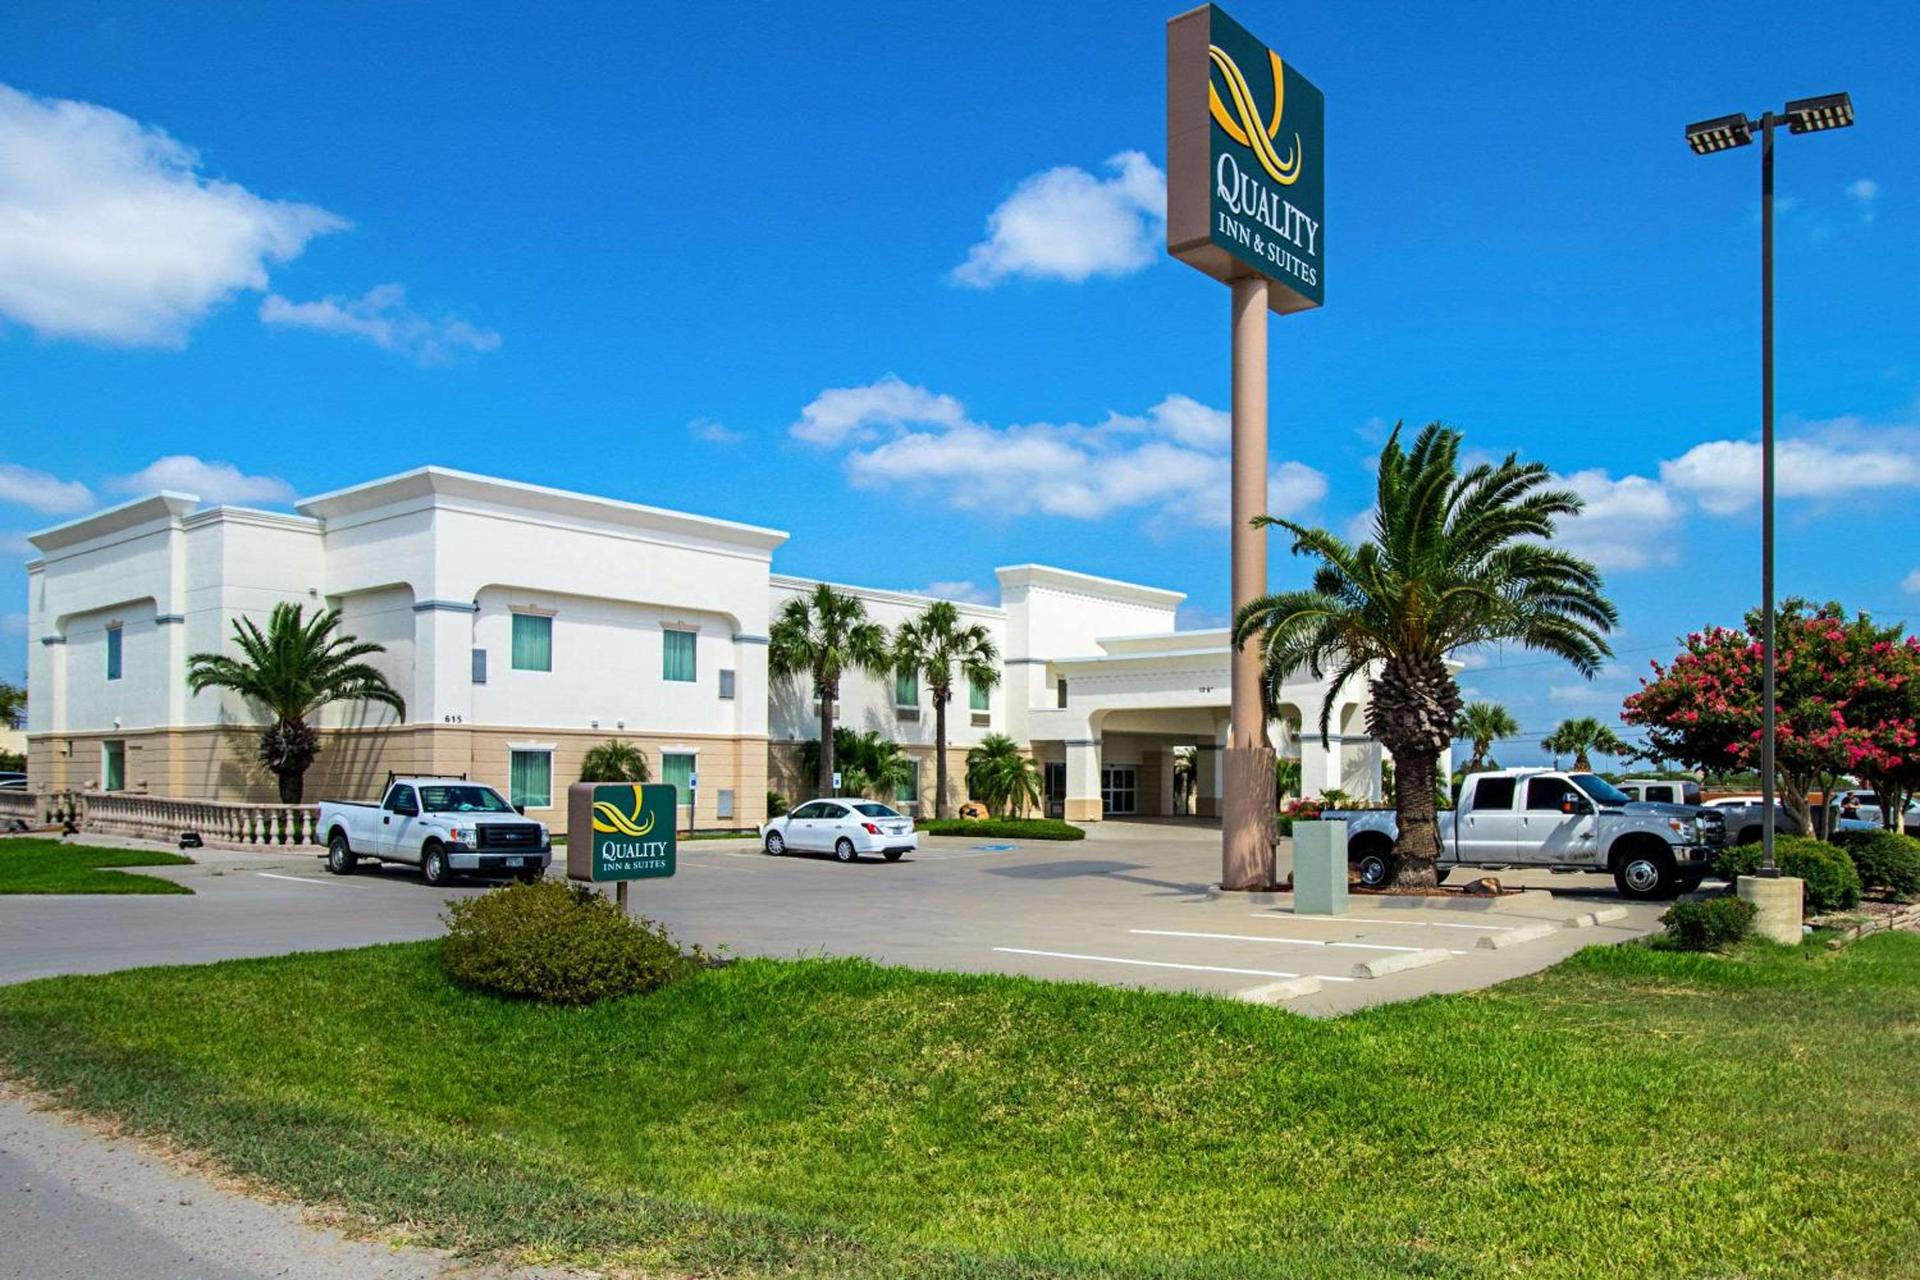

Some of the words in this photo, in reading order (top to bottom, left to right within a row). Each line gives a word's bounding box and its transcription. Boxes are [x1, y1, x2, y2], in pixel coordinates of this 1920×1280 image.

[1216, 152, 1319, 257] QUALITY
[1218, 211, 1251, 248] INN
[1253, 233, 1265, 256] &
[1267, 241, 1317, 287] SUITES
[444, 714, 462, 723] 615
[602, 841, 668, 861] QUALITY
[603, 863, 622, 872] INN
[624, 862, 631, 870] &
[633, 860, 665, 870] SUITES
